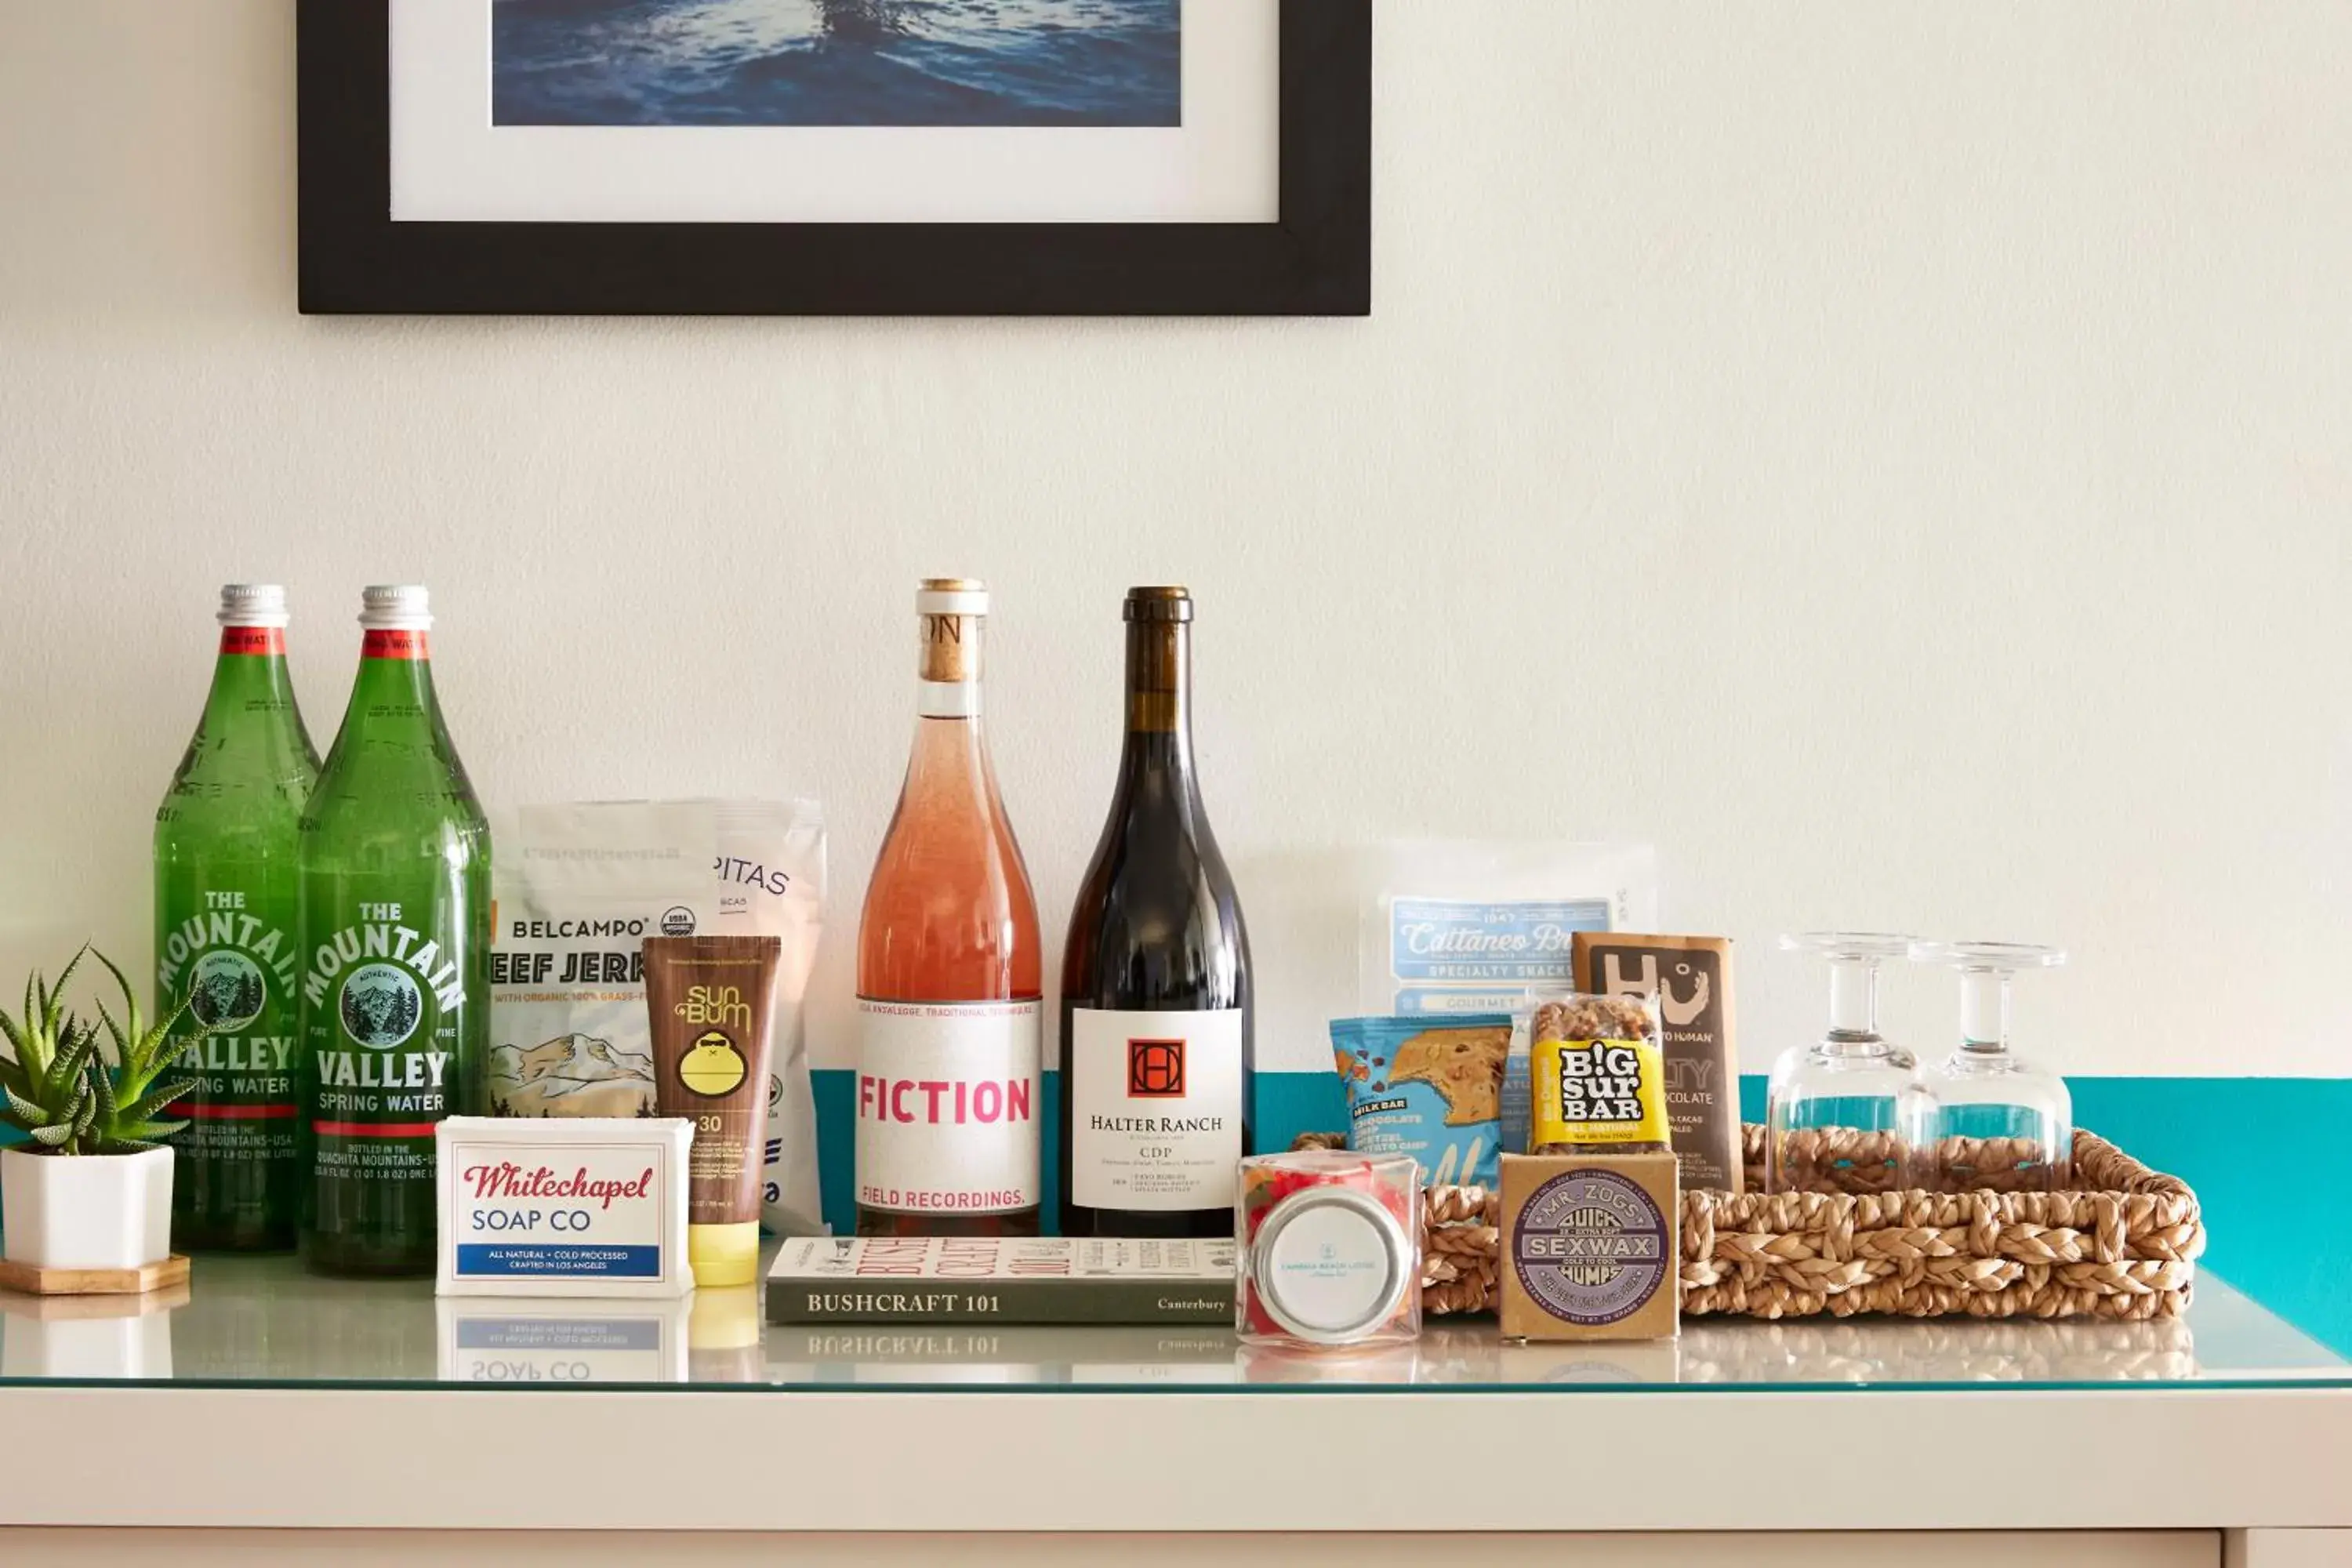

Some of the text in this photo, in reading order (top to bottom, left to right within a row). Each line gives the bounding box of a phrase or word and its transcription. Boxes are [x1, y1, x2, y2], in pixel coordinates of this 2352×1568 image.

[205, 891, 245, 909] THE
[359, 902, 402, 921] THE
[513, 920, 644, 938] BELCAMPO
[1400, 923, 1572, 954] Cattaneo Br
[304, 924, 467, 1013] MOUNTAIN
[489, 952, 644, 984] EEF JERK
[1428, 964, 1508, 977] SPECIALTY
[495, 993, 523, 1003] WITH
[524, 993, 568, 1003] ORGANIC
[601, 992, 647, 1003] GRASS-F
[1446, 996, 1515, 1008] GOURMET
[317, 1051, 448, 1087] VALLEY
[232, 1077, 290, 1094] WATER
[319, 1092, 445, 1111] SPRING WATER
[859, 1075, 1030, 1124] FICTION
[1354, 1100, 1405, 1117] MILK BAR
[1564, 1099, 1642, 1120] BAR
[699, 1116, 722, 1132] 30
[1091, 1116, 1222, 1132] HALTER RANCH
[1139, 1147, 1172, 1158] CDP
[464, 1161, 654, 1210] Whitechapel
[862, 1185, 1025, 1207] FIELD RECORDINGS.
[1584, 1184, 1639, 1218] ZOGS
[472, 1209, 591, 1232] SOAP CO
[1559, 1208, 1622, 1227] QUICK
[488, 1250, 629, 1261] ALL NATURAL COLD PROCESSED
[1530, 1236, 1650, 1256] SEXWAX
[510, 1261, 608, 1270] CRAFTED IN LOS ANGELES
[808, 1294, 1226, 1313] BUSHCRAFT 101 Canterbury
